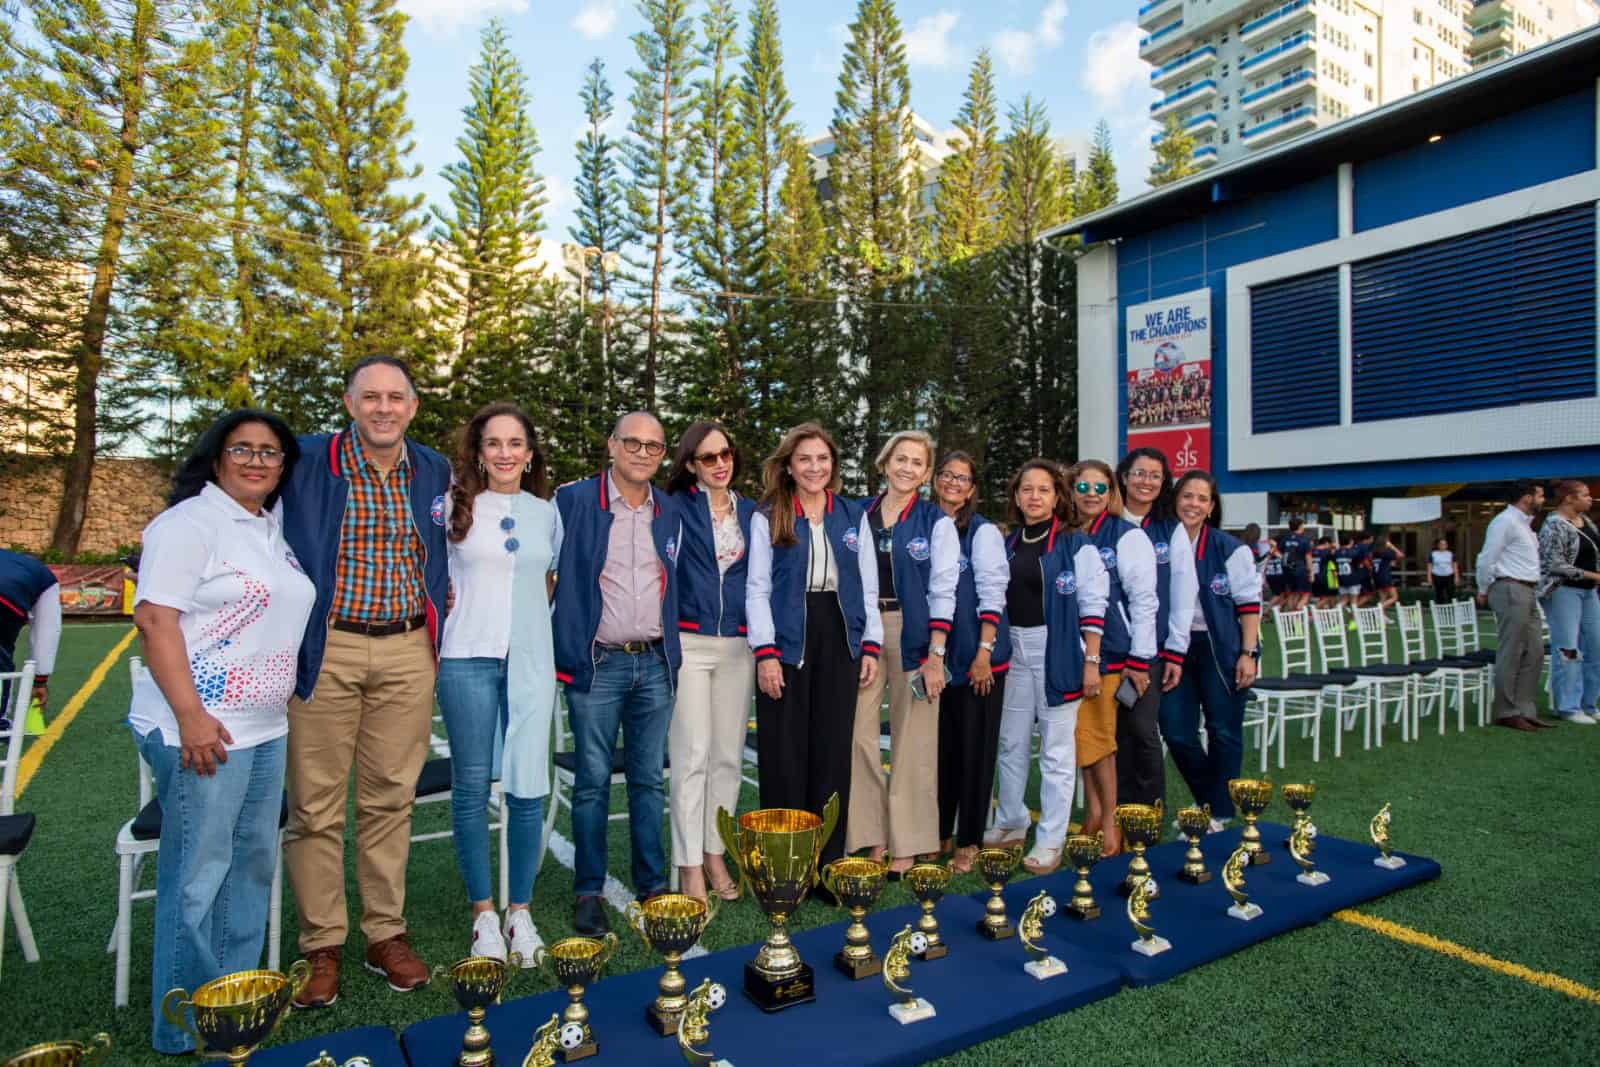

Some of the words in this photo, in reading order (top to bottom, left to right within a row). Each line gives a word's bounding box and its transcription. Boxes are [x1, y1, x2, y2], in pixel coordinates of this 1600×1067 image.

[1145, 312, 1163, 328] WE
[1167, 306, 1191, 323] ARE
[1130, 328, 1146, 343] THE
[1149, 316, 1207, 338] CHAMPIONS
